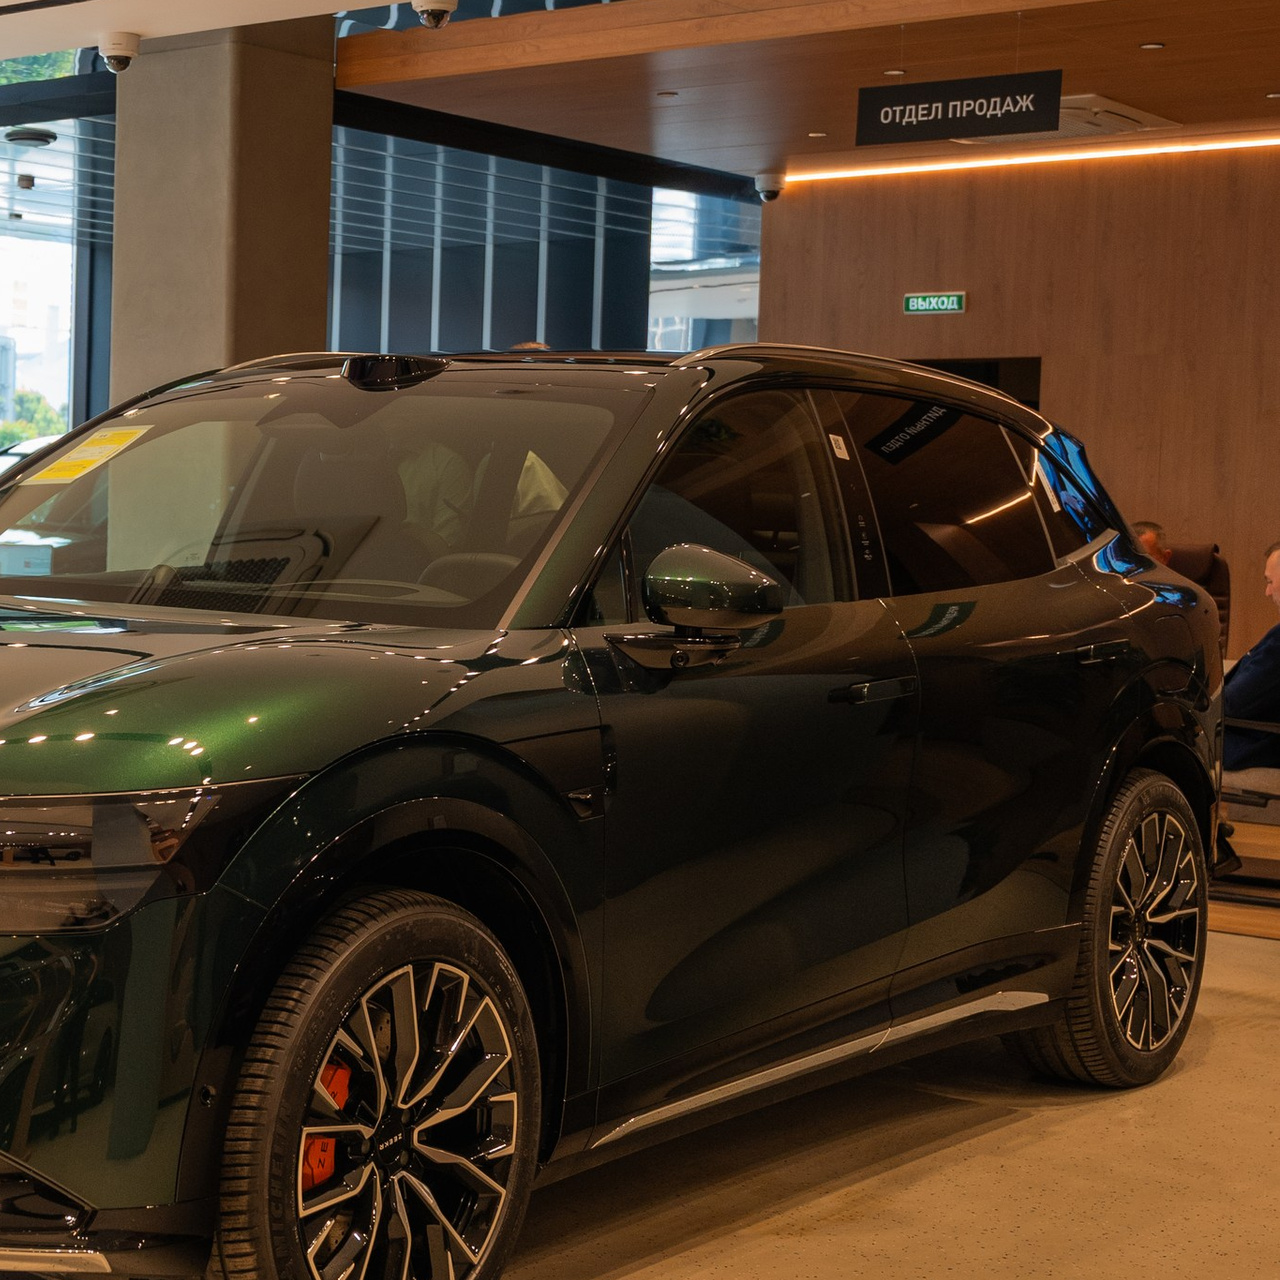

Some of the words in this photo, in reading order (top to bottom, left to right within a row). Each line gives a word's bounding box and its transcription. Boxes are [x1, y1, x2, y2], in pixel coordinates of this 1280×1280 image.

[880, 102, 942, 126] ОТДЕЛ
[948, 94, 1035, 119] ПРОДАЖ
[909, 296, 958, 310] ВЫХОД
[379, 1132, 403, 1151] ZEEKR
